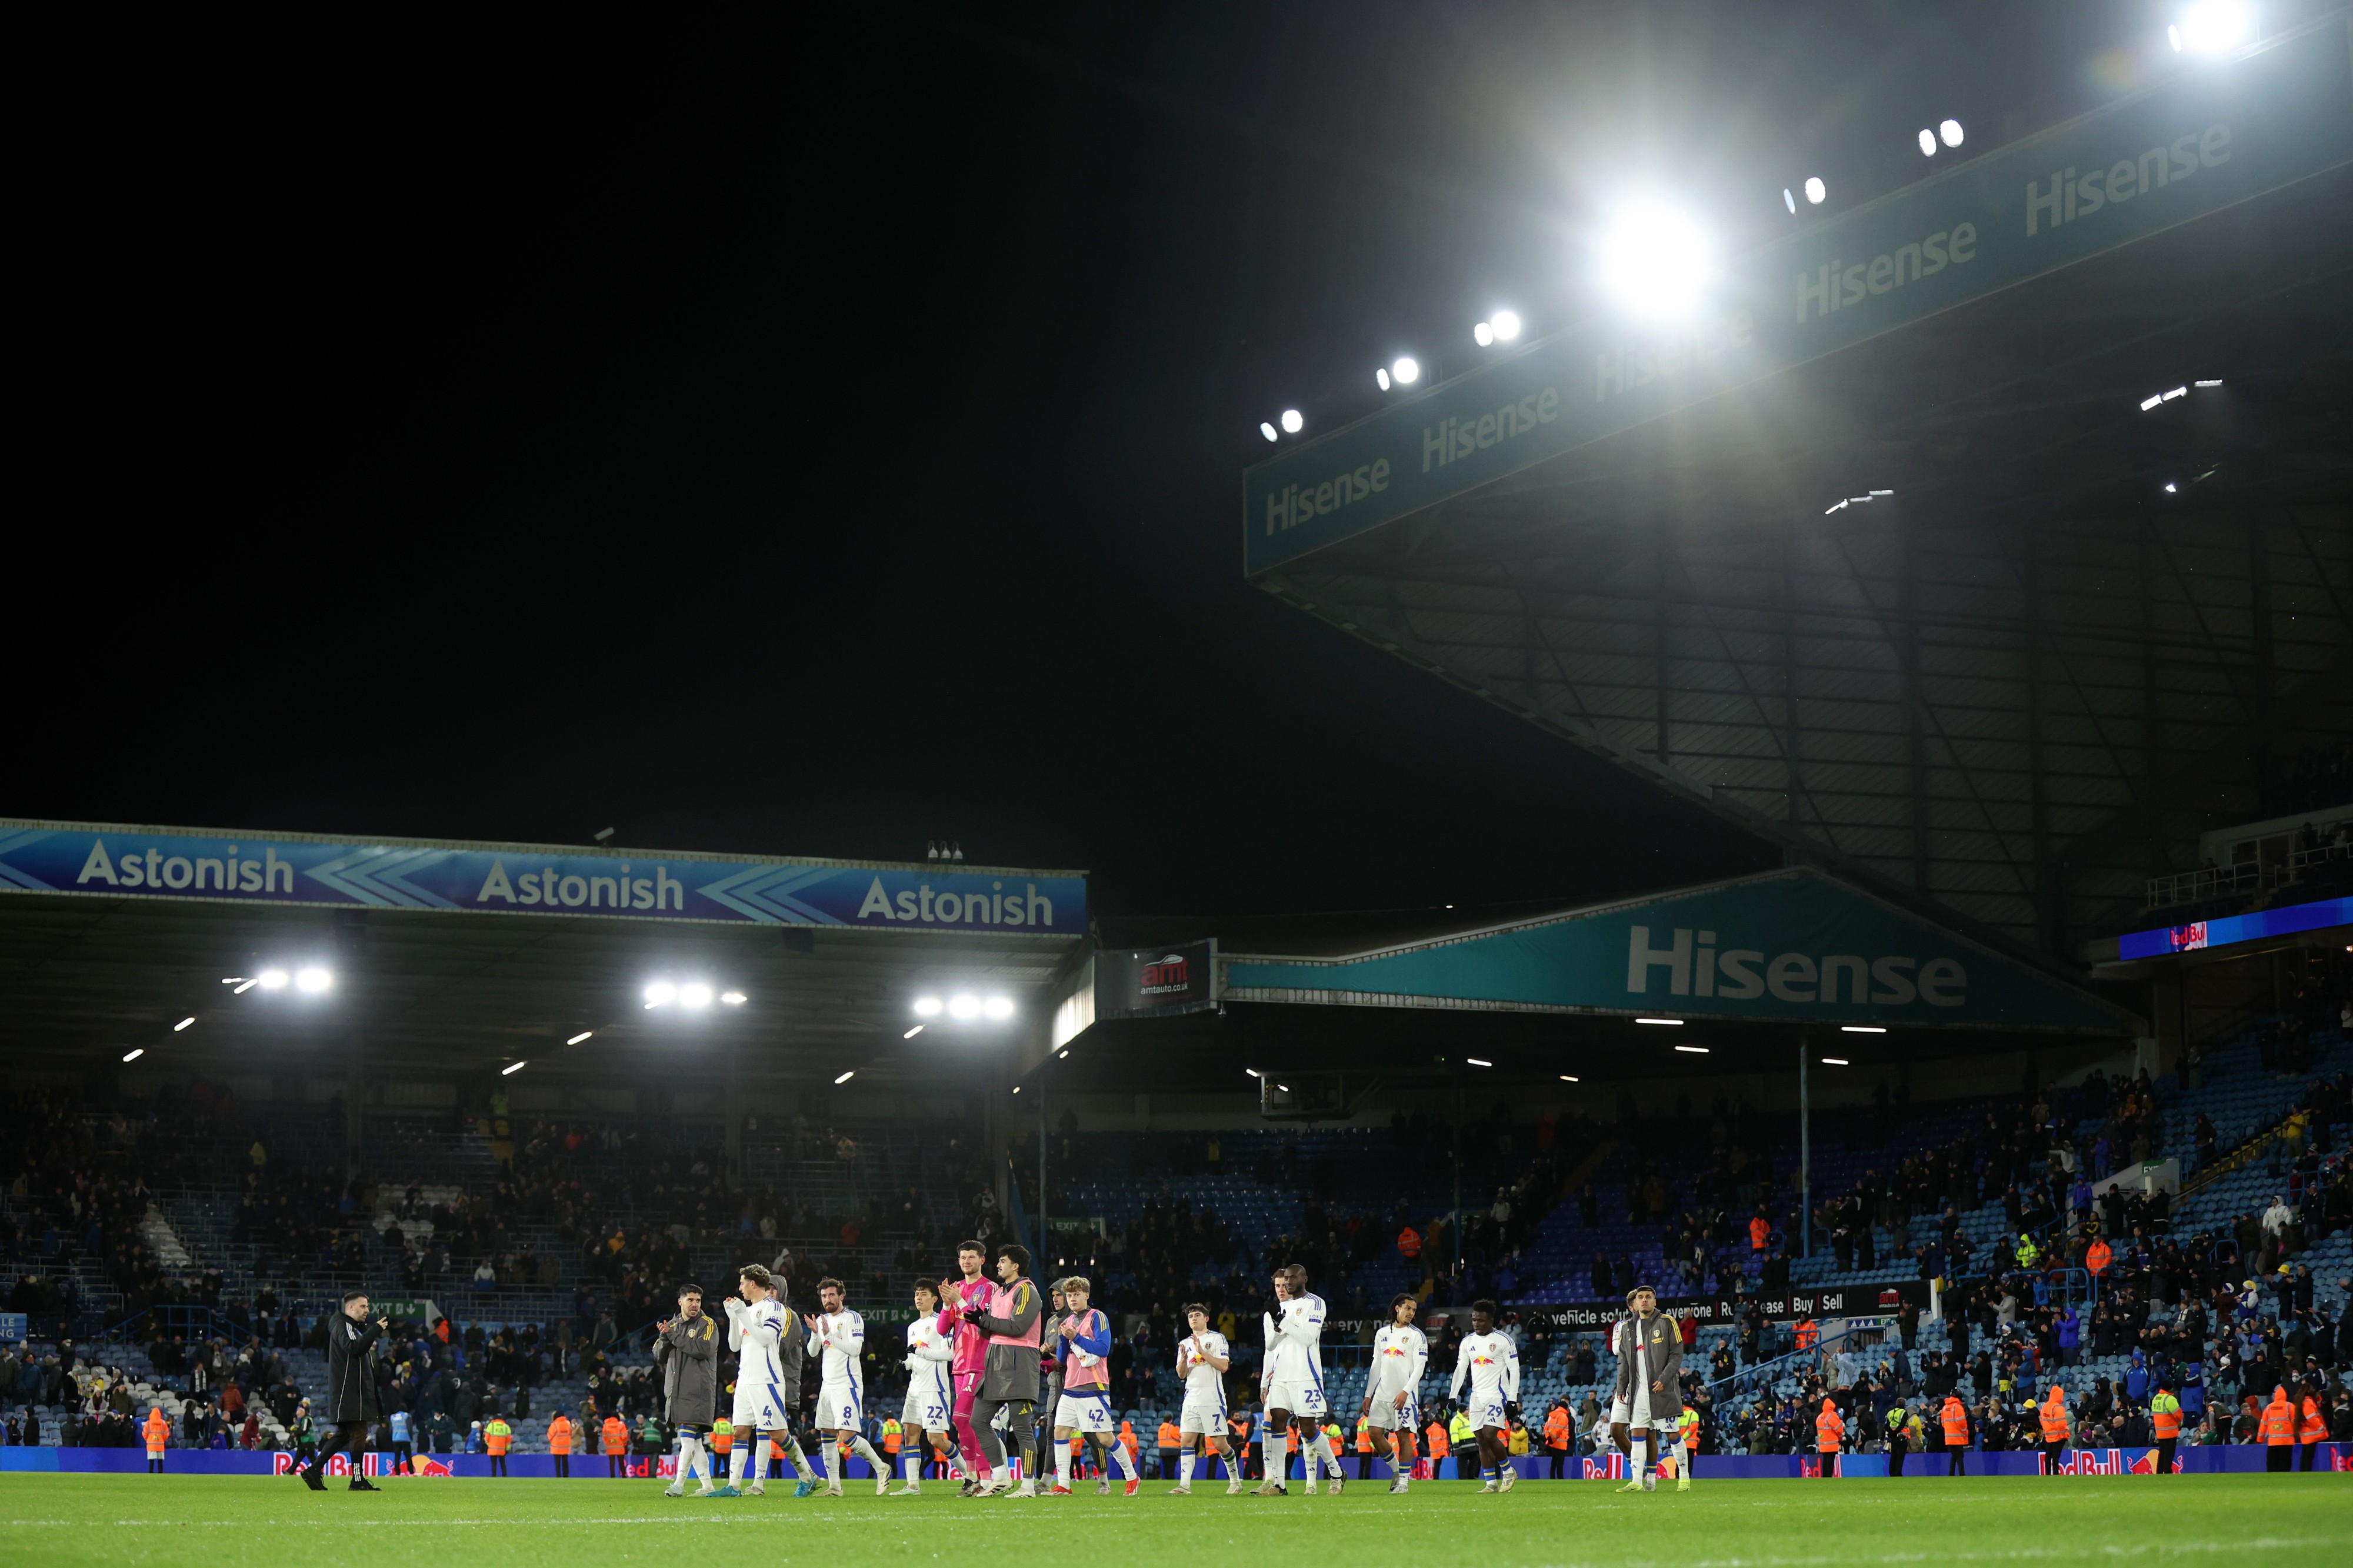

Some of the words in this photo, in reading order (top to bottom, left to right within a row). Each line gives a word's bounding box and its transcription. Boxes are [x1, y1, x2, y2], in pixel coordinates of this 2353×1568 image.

[2027, 122, 2232, 236] Hisense
[1797, 222, 1976, 323] Hisense
[1423, 386, 1559, 473] Hisense
[1267, 458, 1389, 536] Hisense
[76, 838, 294, 893] Astonish
[476, 859, 684, 910] Astonish
[857, 876, 1052, 926] Astonish
[2171, 927, 2188, 945] Red
[2189, 922, 2206, 942] Bull
[1141, 956, 1189, 986] amt
[1627, 925, 1967, 1006] Hisense
[1141, 981, 1188, 995] amtauto.co.uk
[2144, 1165, 2159, 1174] EX
[1879, 1290, 1899, 1303] amt
[368, 1302, 392, 1314] XIT
[859, 1310, 888, 1320] EXIT
[1552, 1310, 1597, 1325] vehicle
[1794, 1296, 1814, 1315] Buy
[1823, 1293, 1842, 1310] Sell
[2, 1317, 15, 1327] LE
[1321, 1319, 1390, 1333] eeryne
[968, 1373, 975, 1385] 1
[1305, 1390, 1321, 1403] 23
[763, 1405, 772, 1419] 4
[843, 1406, 852, 1419] 8
[927, 1406, 943, 1419] 22
[1089, 1409, 1104, 1422] 42
[1487, 1405, 1502, 1417] 29
[1212, 1414, 1220, 1426] 7
[274, 1452, 329, 1476] Re
[330, 1452, 378, 1476] Bll
[1583, 1458, 1608, 1479] Re
[1801, 1457, 1822, 1477] Red
[2081, 1449, 2122, 1474] Bull
